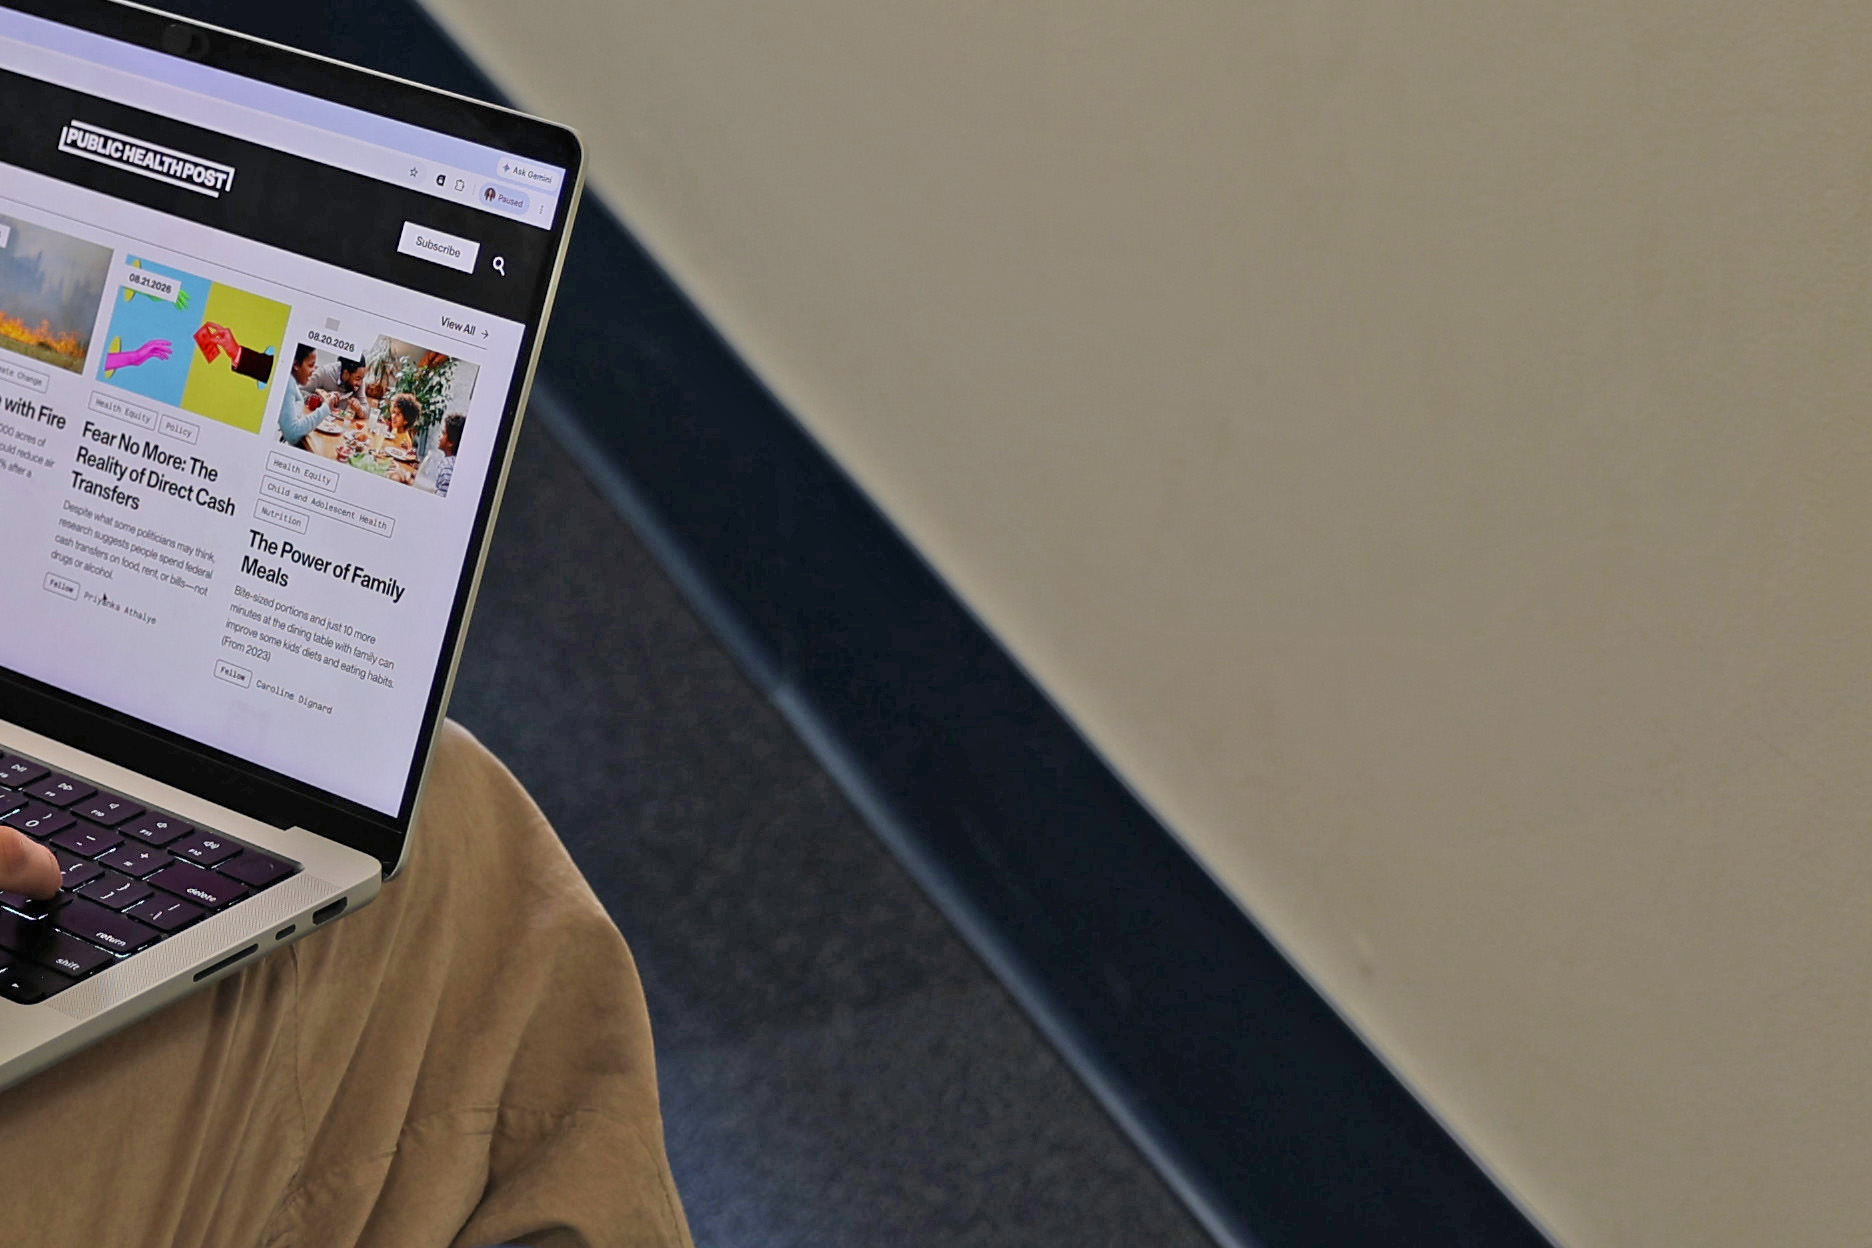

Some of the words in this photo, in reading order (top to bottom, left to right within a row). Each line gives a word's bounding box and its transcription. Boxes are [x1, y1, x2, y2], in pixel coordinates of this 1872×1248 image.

[512, 166, 525, 176] Ask
[527, 170, 552, 183] Gemini
[497, 193, 523, 208] Paused
[415, 235, 460, 257] Subscribe
[129, 273, 171, 293] 08.21.2026
[441, 315, 463, 331] View
[462, 323, 476, 335] All
[308, 330, 354, 352] 08.20.2026
[16, 371, 42, 386] Change
[4, 397, 35, 419] with
[37, 405, 66, 429] Fire
[95, 398, 121, 413] Health
[124, 407, 150, 424] Equity
[14, 431, 36, 444] acres
[36, 438, 46, 447] of
[165, 421, 192, 438] Policy
[16, 449, 44, 464] reduce
[43, 458, 55, 468] air
[82, 420, 117, 446] Fear
[117, 433, 139, 455] No
[141, 441, 186, 471] More:
[190, 456, 218, 482] The
[7, 462, 25, 475] after
[76, 445, 127, 481] Reality
[129, 467, 146, 484] of
[146, 470, 193, 501] Direct
[195, 487, 235, 516] Cash
[273, 459, 300, 474] Health
[303, 469, 331, 485] Equity
[72, 470, 139, 509] Transfers
[260, 506, 301, 526] Nutrition
[267, 482, 290, 496] Child
[293, 493, 308, 502] and
[310, 498, 355, 519] Adolescent
[358, 514, 386, 530] Health
[62, 499, 93, 518] Despite
[93, 512, 113, 526] what
[113, 520, 136, 534] some
[135, 528, 176, 548] politicians
[176, 542, 194, 556] may
[194, 547, 215, 564] think,
[54, 534, 74, 547] cash
[74, 540, 108, 560] transfers
[109, 554, 120, 564] on
[121, 556, 140, 573] food,
[141, 566, 158, 580] rent,
[159, 572, 170, 582] or
[58, 518, 93, 536] research
[93, 530, 129, 549] suggests
[129, 543, 158, 560] people
[158, 554, 184, 569] spend
[184, 561, 213, 579] federal
[50, 549, 73, 565] drugs
[73, 559, 83, 568] or
[83, 562, 113, 580] alcohol.
[241, 555, 288, 587] Meals
[249, 529, 278, 555] The
[280, 541, 331, 573] Power
[332, 563, 351, 580] of
[351, 566, 405, 603] Family
[49, 579, 73, 593] Fellow
[123, 606, 156, 624] Athalye
[234, 585, 275, 608] Bite-sized
[274, 602, 309, 620] portions
[309, 614, 326, 626] and
[325, 618, 342, 632] just
[343, 624, 353, 636] 10
[353, 630, 376, 644] more
[221, 635, 245, 652] (From
[245, 644, 271, 662] 2023)
[229, 603, 261, 622] minutes
[262, 615, 271, 625] at
[272, 617, 286, 630] the
[286, 623, 312, 642] dining
[312, 632, 333, 647] table
[334, 641, 352, 654] with
[352, 646, 378, 665] family
[378, 657, 394, 670] can
[225, 618, 258, 638] improve
[258, 632, 282, 647] some
[301, 647, 322, 662] diets
[322, 656, 340, 668] and
[340, 662, 366, 680] eating
[366, 669, 393, 688] habits.
[220, 666, 245, 681] Fellow
[255, 679, 294, 700] Caroline
[297, 695, 332, 714] Dignard
[186, 887, 217, 903] delete
[95, 930, 127, 947] return
[55, 957, 81, 971] shift
